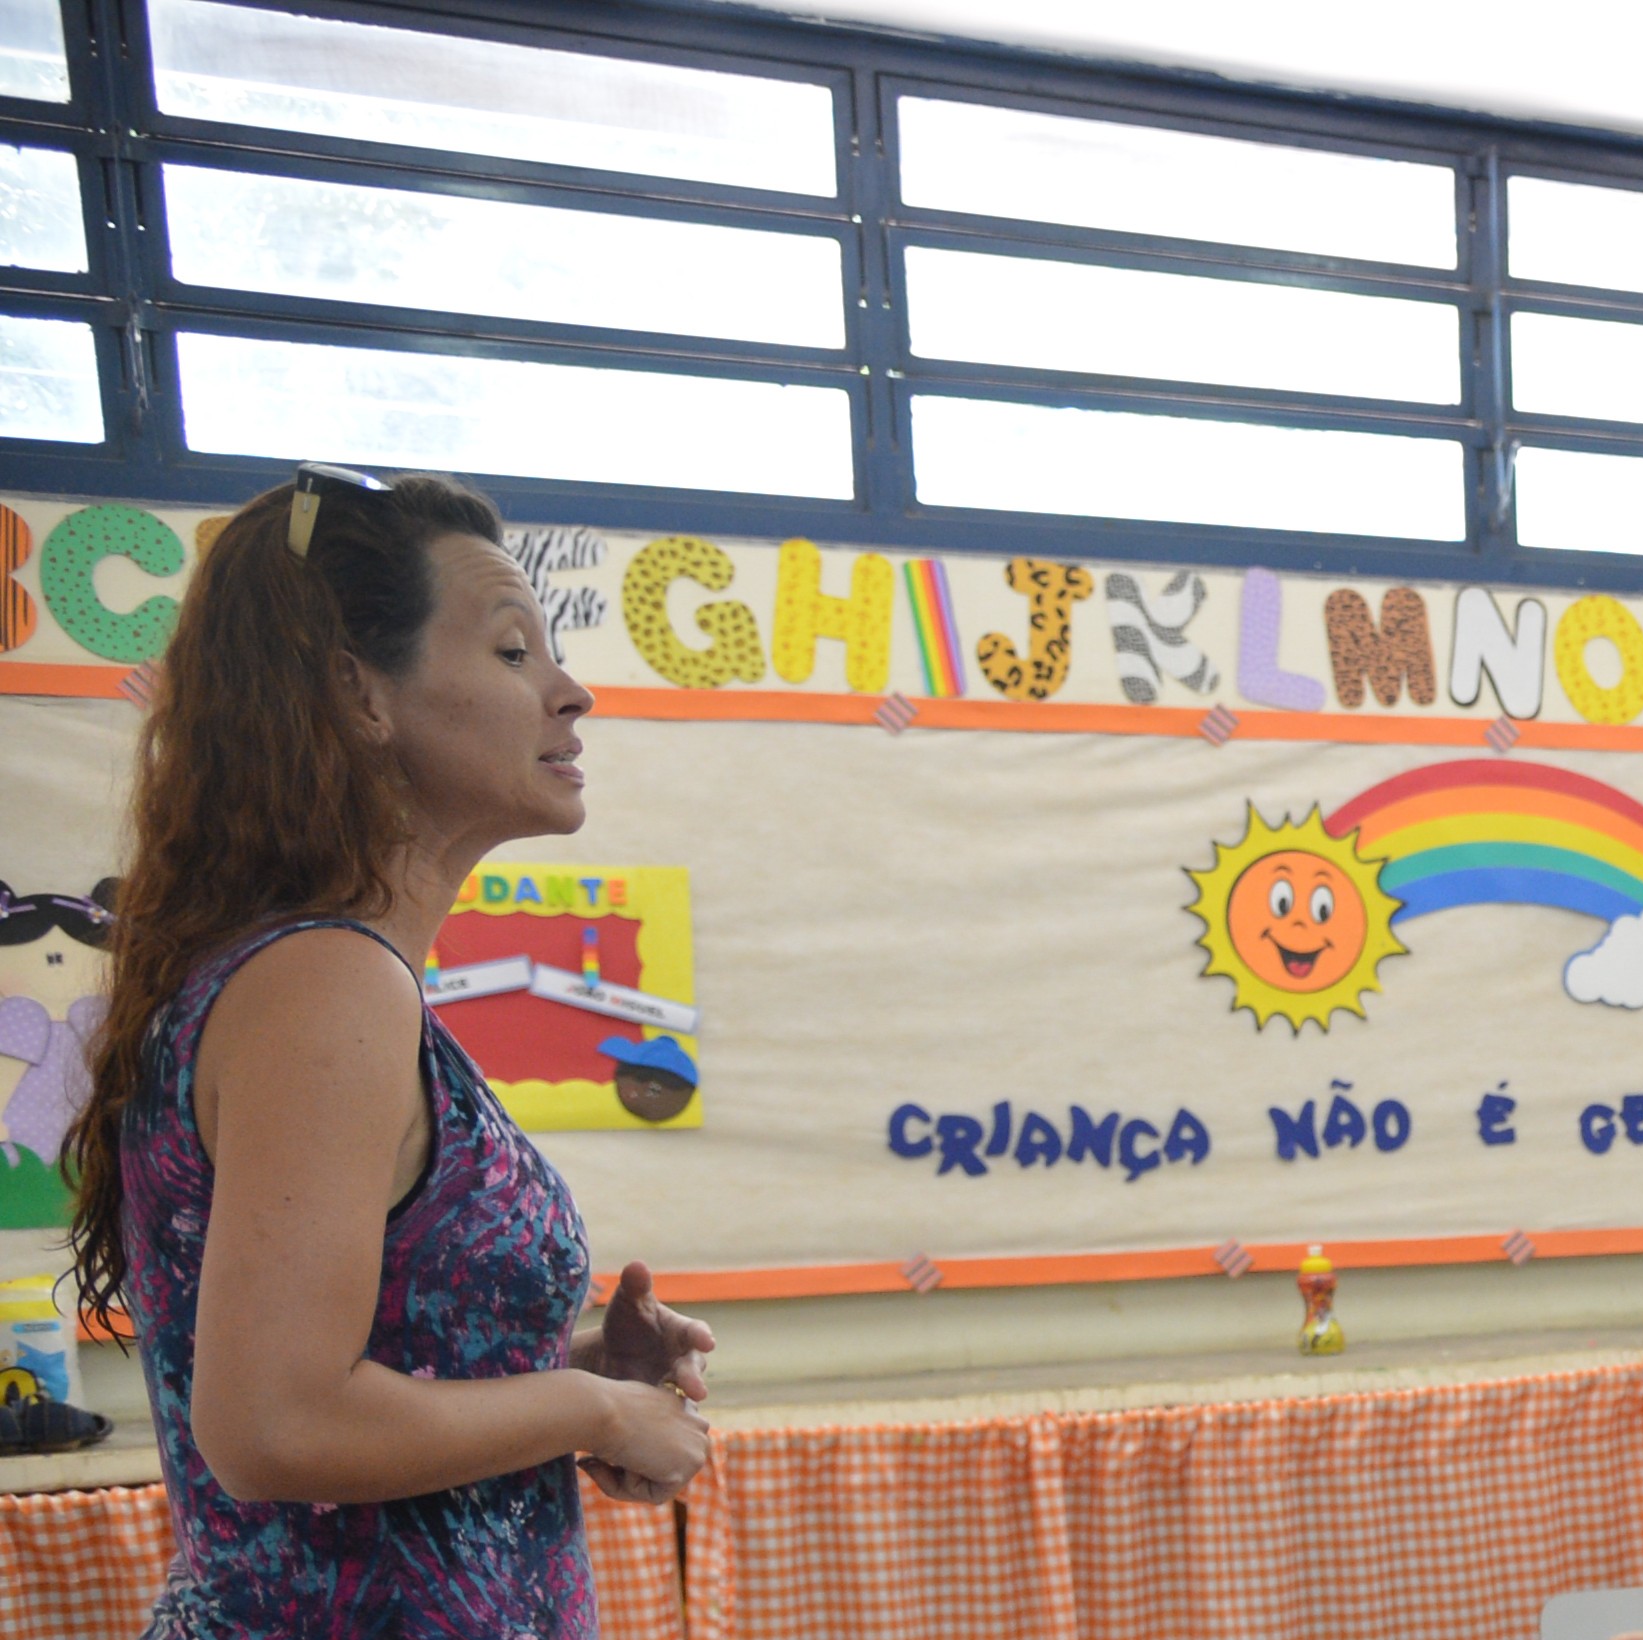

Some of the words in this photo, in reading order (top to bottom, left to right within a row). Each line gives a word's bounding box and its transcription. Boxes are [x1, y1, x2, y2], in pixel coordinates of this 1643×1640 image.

[889, 1101, 1211, 1182] CRIANÇA
[1269, 1079, 1411, 1162] NÃO
[1477, 1081, 1516, 1146] É
